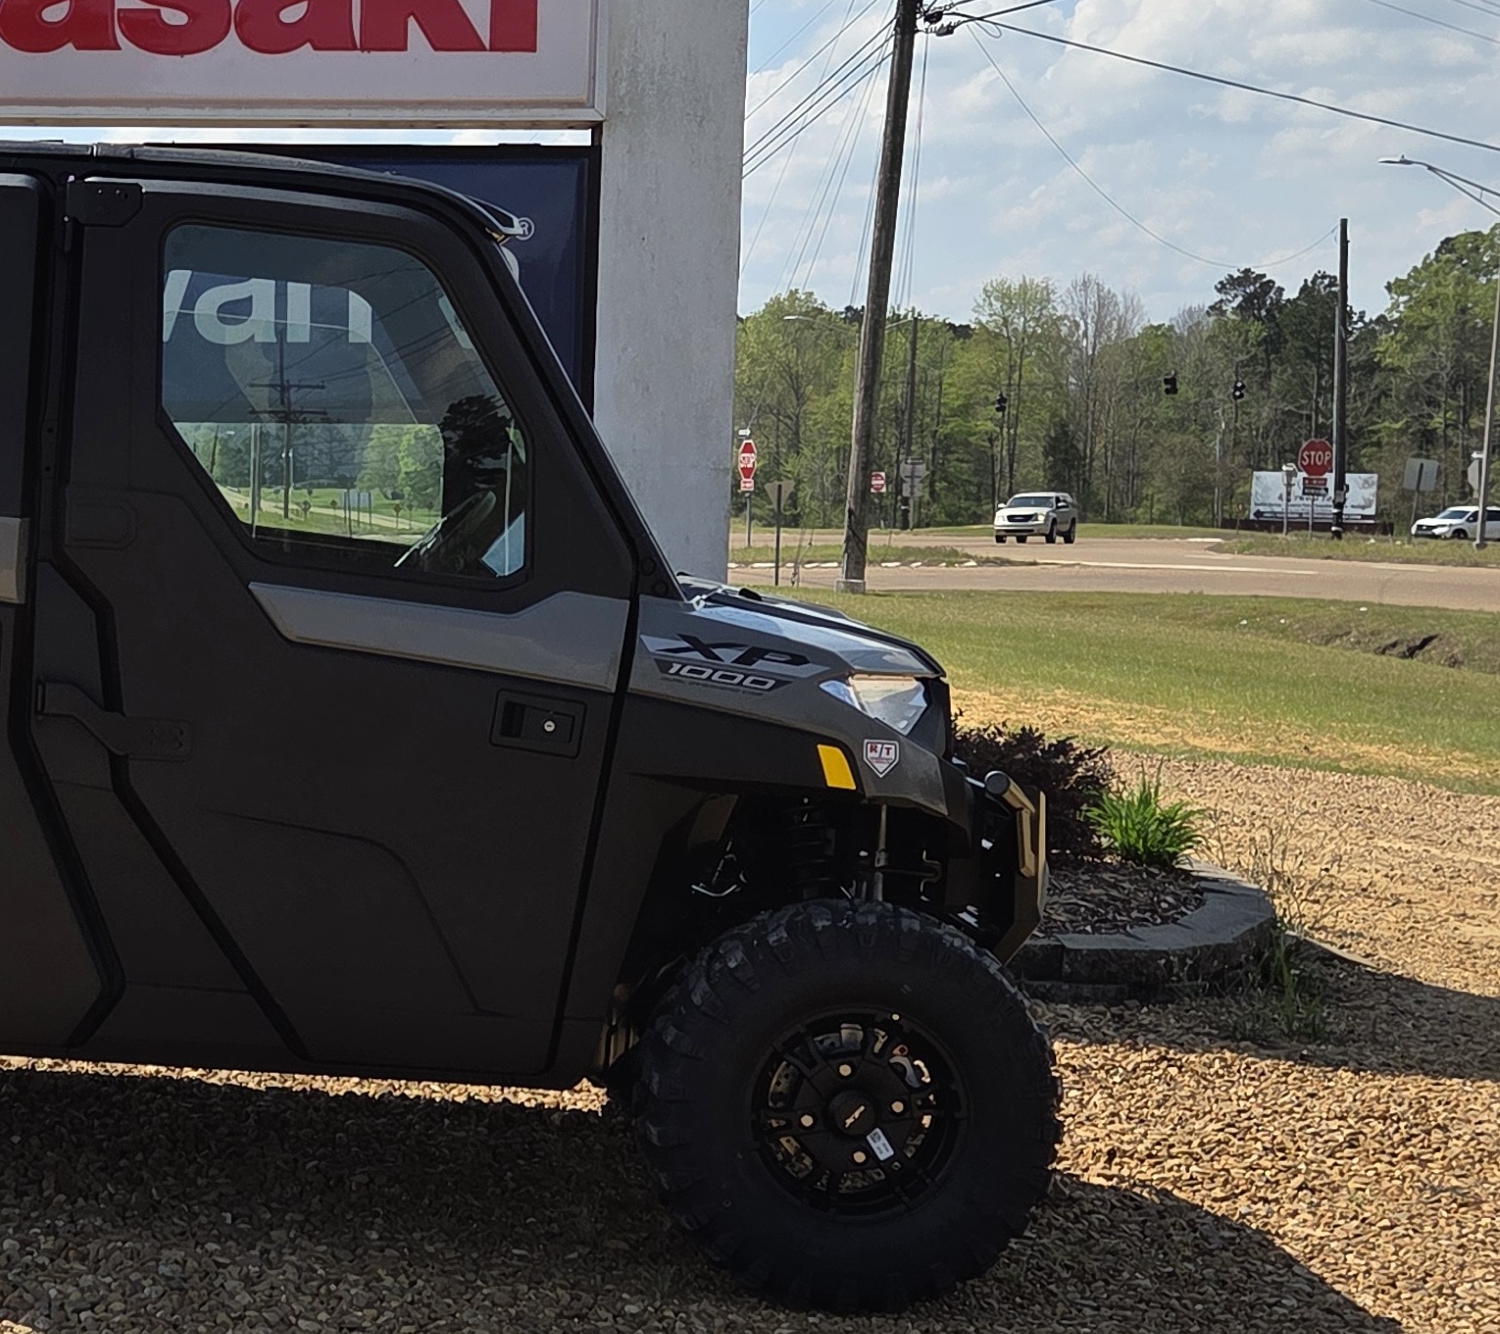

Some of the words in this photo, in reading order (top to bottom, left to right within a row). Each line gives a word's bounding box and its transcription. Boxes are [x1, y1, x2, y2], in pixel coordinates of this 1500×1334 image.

[1302, 451, 1332, 466] STOP
[654, 633, 812, 667] XP
[667, 662, 776, 690] 1000
